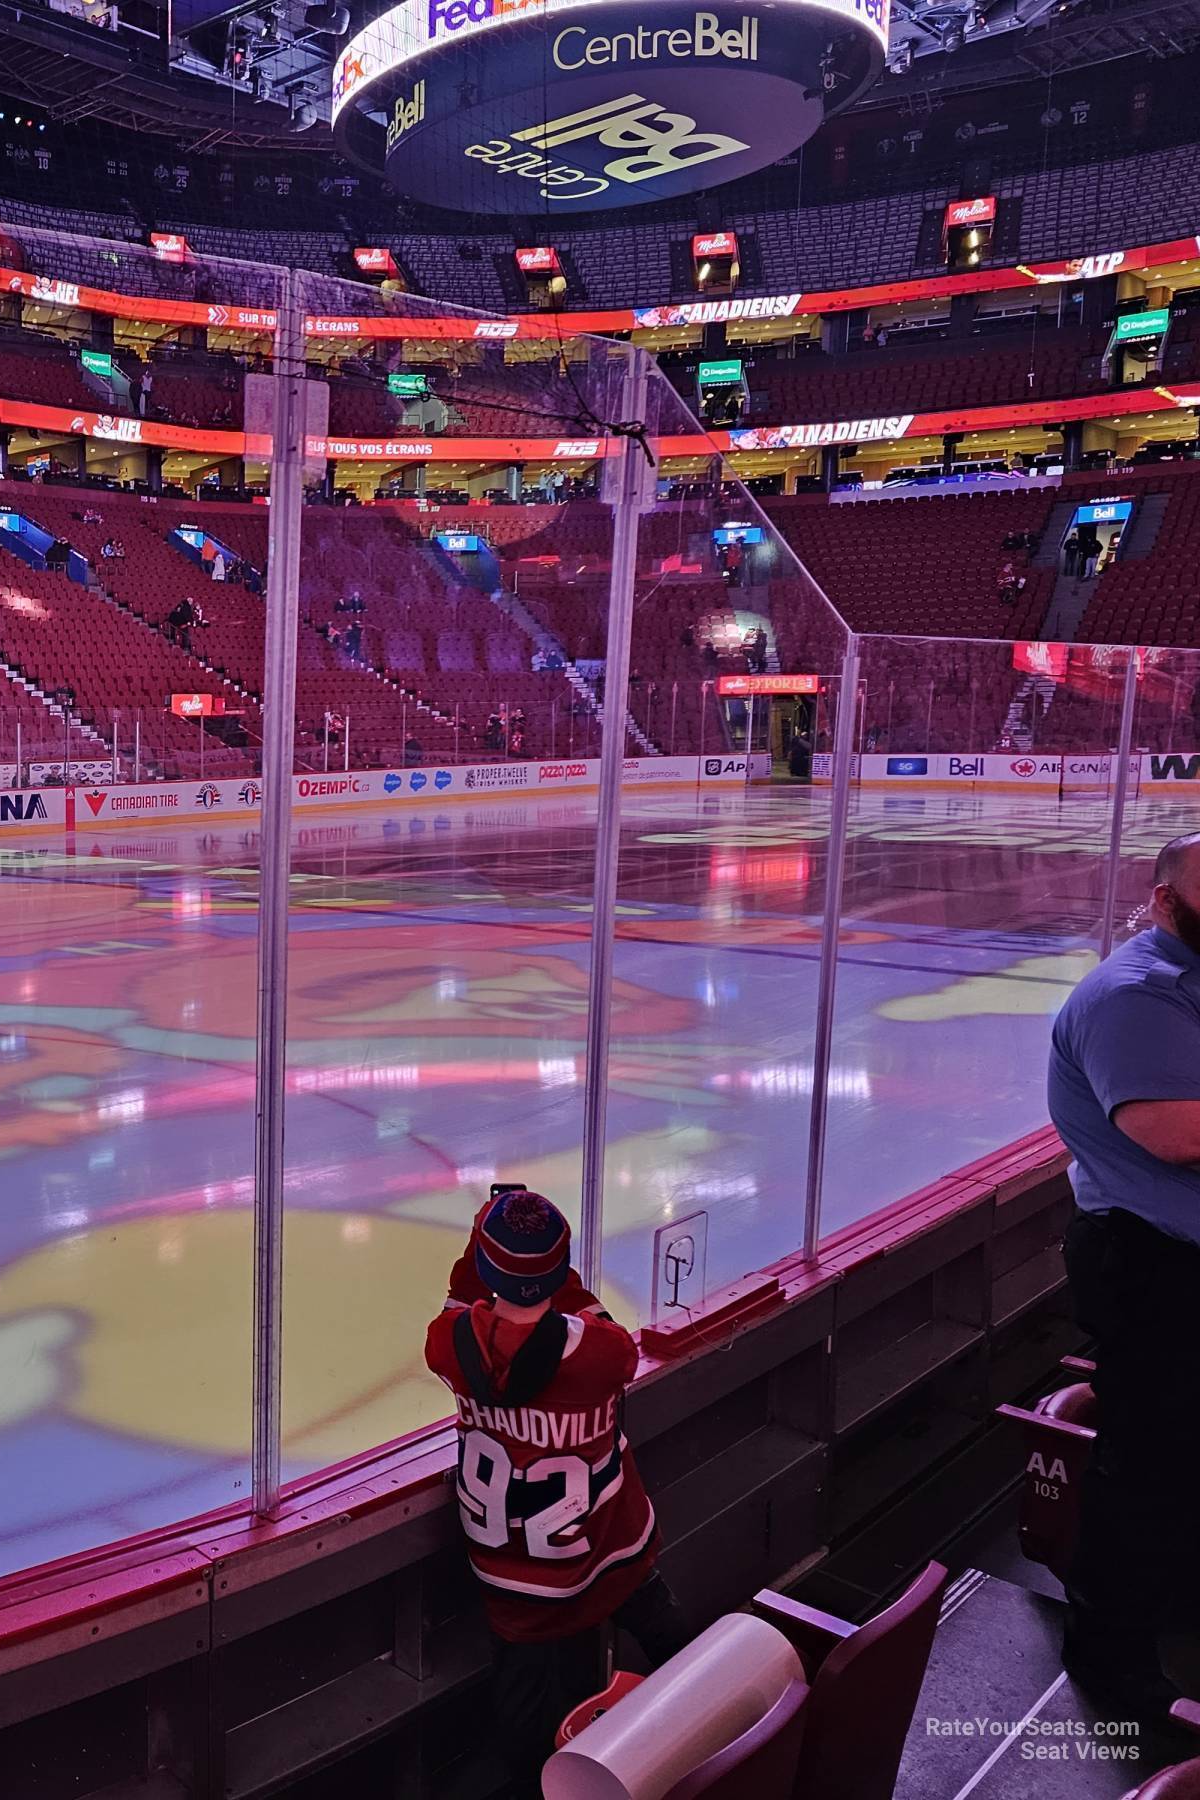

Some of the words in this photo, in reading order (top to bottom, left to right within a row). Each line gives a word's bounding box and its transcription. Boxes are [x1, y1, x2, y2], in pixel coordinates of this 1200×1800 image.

[509, 93, 751, 184] Bell
[463, 139, 610, 200] Centre
[1082, 252, 1125, 277] ATP
[238, 312, 258, 325] SUR
[260, 313, 277, 326] TO
[679, 297, 789, 323] CANADIENS
[316, 318, 359, 332] ÉCRANS
[474, 322, 519, 337] RDS
[118, 418, 143, 440] NFL
[780, 418, 899, 444] CANADIENS
[328, 442, 357, 453] TOUS
[360, 442, 383, 454] VOS
[385, 440, 433, 455] ÉCRANS
[553, 441, 601, 456] RDS
[1093, 506, 1116, 519] Bell
[448, 537, 467, 549] Bell
[538, 765, 564, 783] pizza
[564, 763, 587, 782] pizza
[949, 757, 984, 776] Bell
[111, 796, 157, 811] CANADIAN
[160, 794, 179, 808] TIRE
[1026, 1452, 1069, 1485] AA
[456, 1429, 591, 1560] 92
[1033, 1480, 1060, 1500] 103
